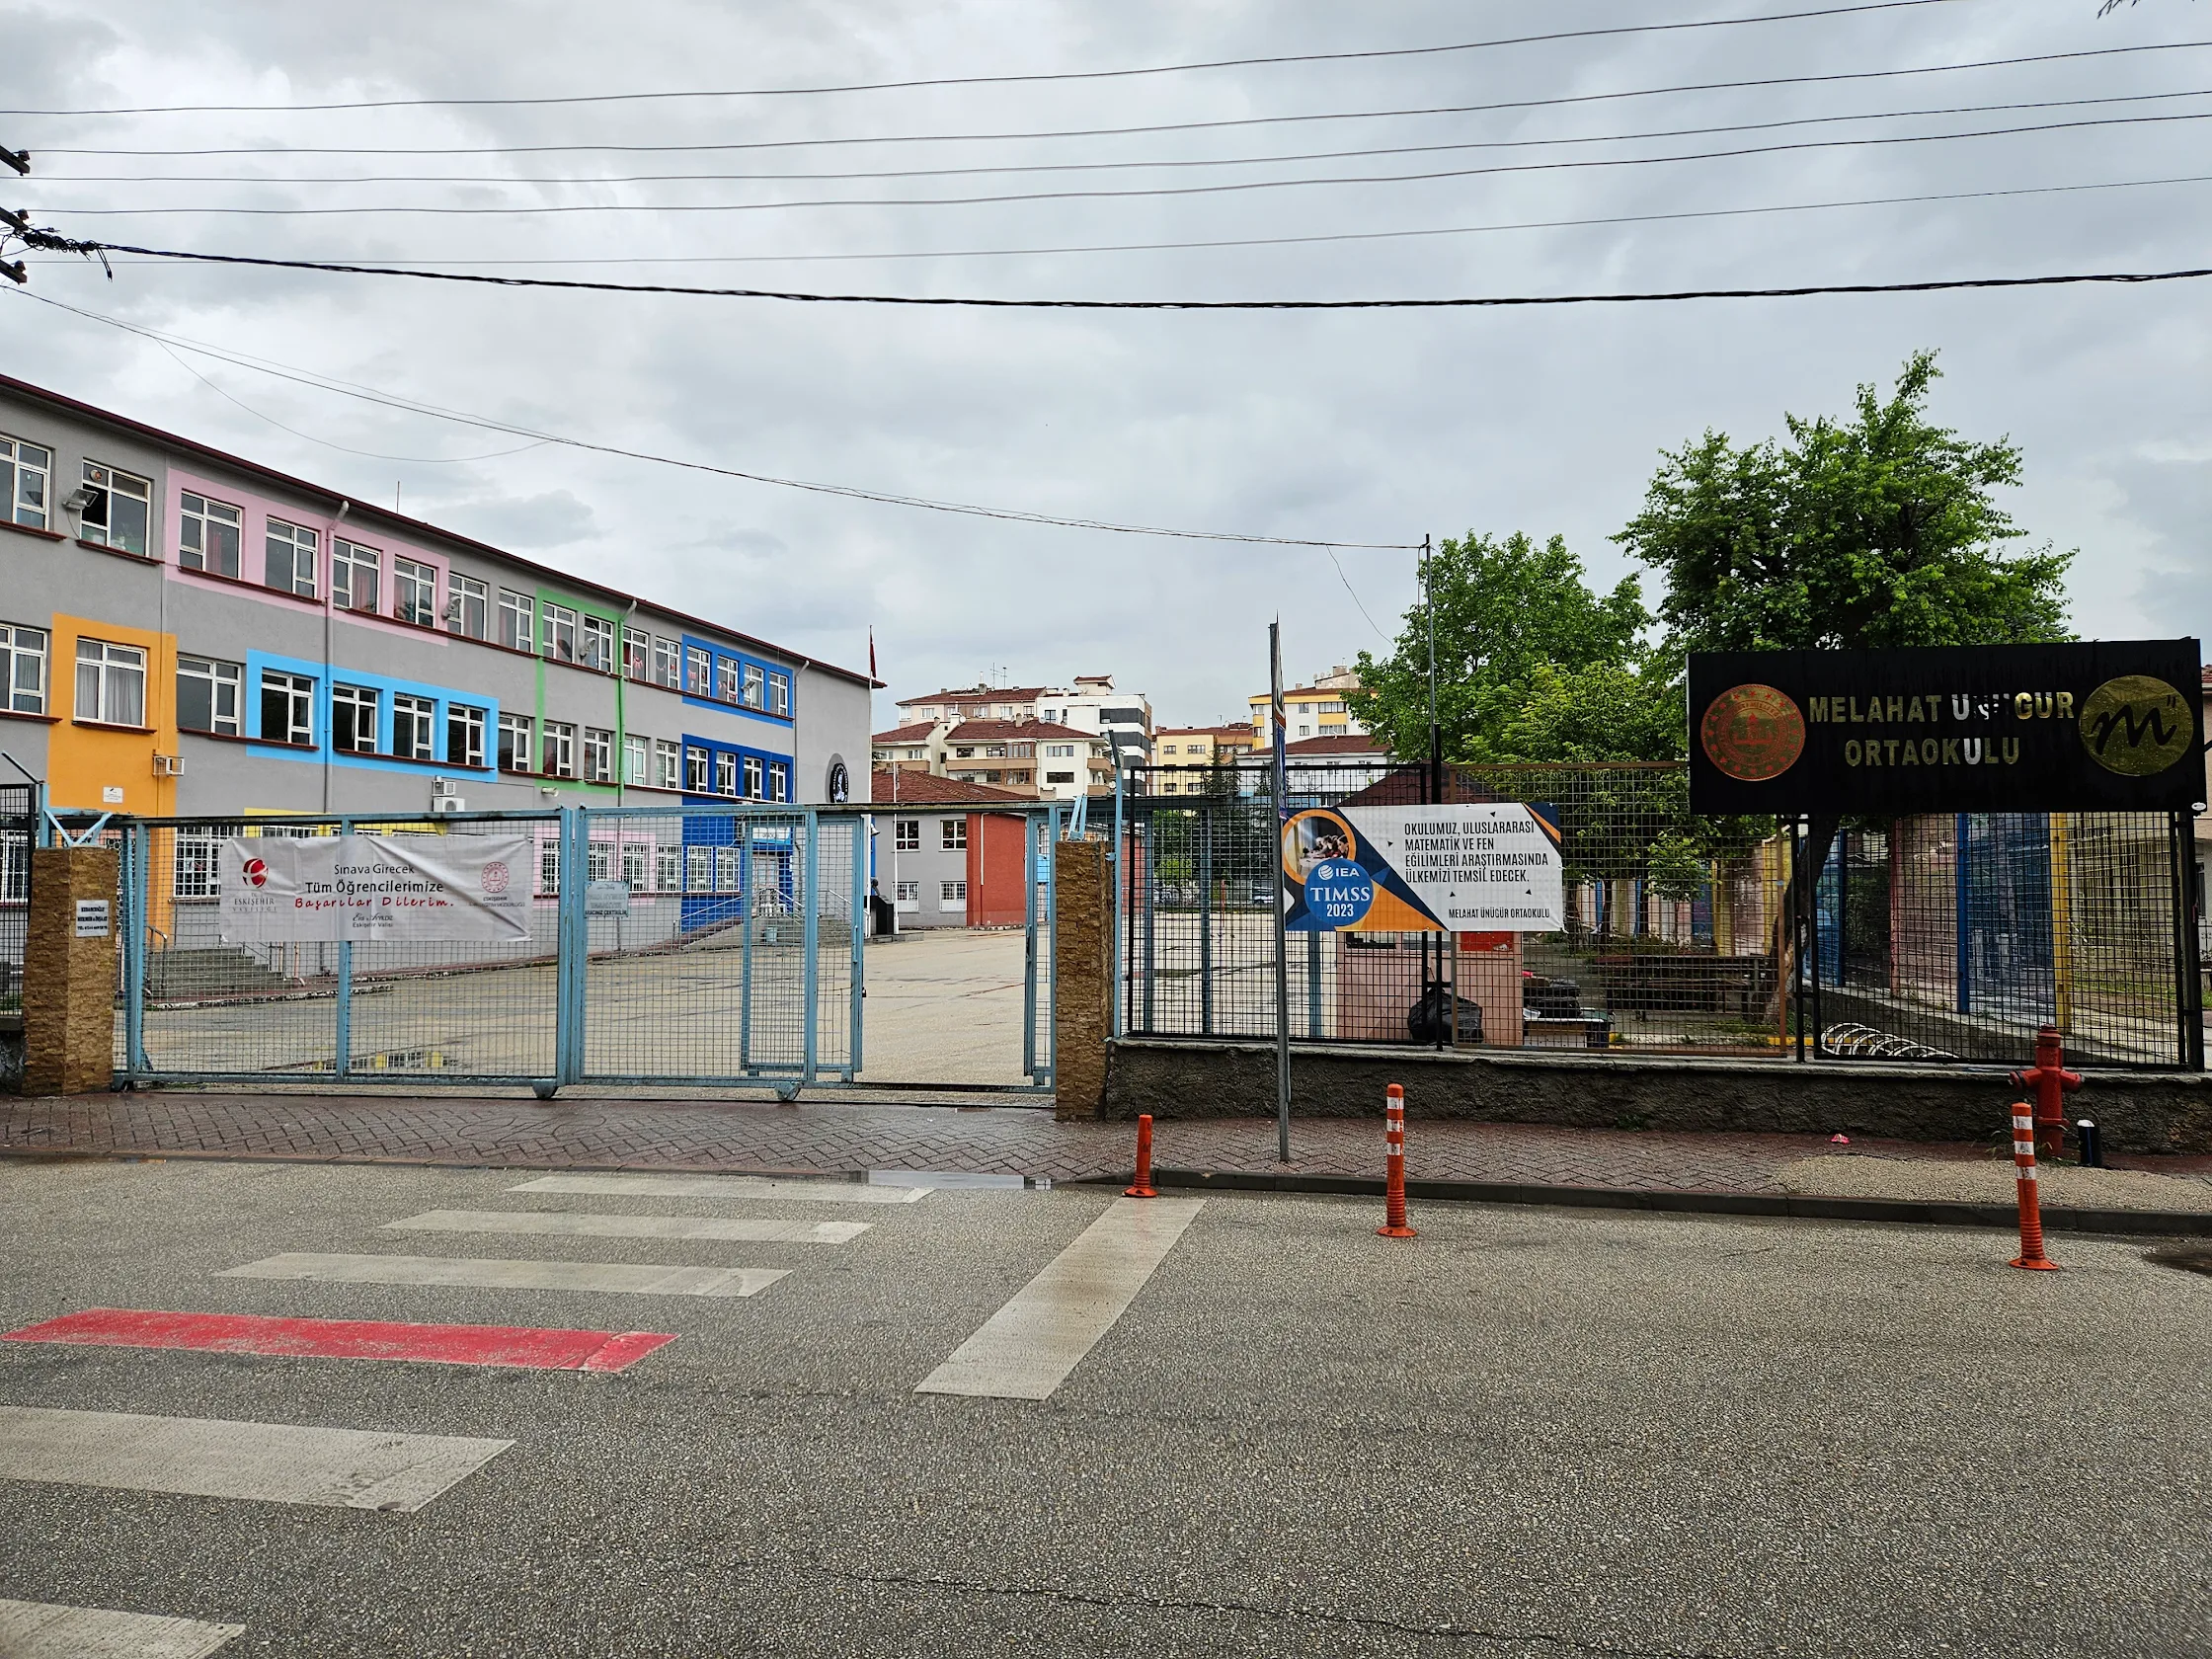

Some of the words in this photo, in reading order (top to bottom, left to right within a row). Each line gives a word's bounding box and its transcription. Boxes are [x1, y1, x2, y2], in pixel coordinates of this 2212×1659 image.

[1809, 694, 1942, 723] MELAHAT
[1845, 737, 2020, 767] ORTAOKULU
[1404, 822, 1461, 836] OKULUMUZ,
[1462, 821, 1535, 834] ULUSLARARASI
[1404, 836, 1461, 851] MATEMATİK
[1462, 837, 1474, 850] VE
[1476, 837, 1494, 849] FEN
[1405, 852, 1460, 867] EĞİLİMLERİ
[1462, 852, 1548, 869] ARAŞTIRMASINDA
[334, 864, 370, 875] Sınava
[372, 863, 415, 874] Girecek
[1335, 867, 1360, 877] IEA
[1405, 868, 1451, 883] ÜLKEMİZİ
[1453, 868, 1488, 883] TEMSİL
[1490, 869, 1530, 883] EDECEK.
[305, 882, 332, 893] Tüm
[336, 879, 444, 895] Öğrencilerimize
[1309, 887, 1371, 902] TIMSS
[295, 897, 372, 910] Başarılar
[382, 897, 453, 907] Dilerim.
[1326, 903, 1354, 917] 2023
[1449, 908, 1478, 918] MELAHAT
[1480, 907, 1509, 918] ÜNÜGÜR
[1511, 908, 1550, 918] ORTAOKULU
